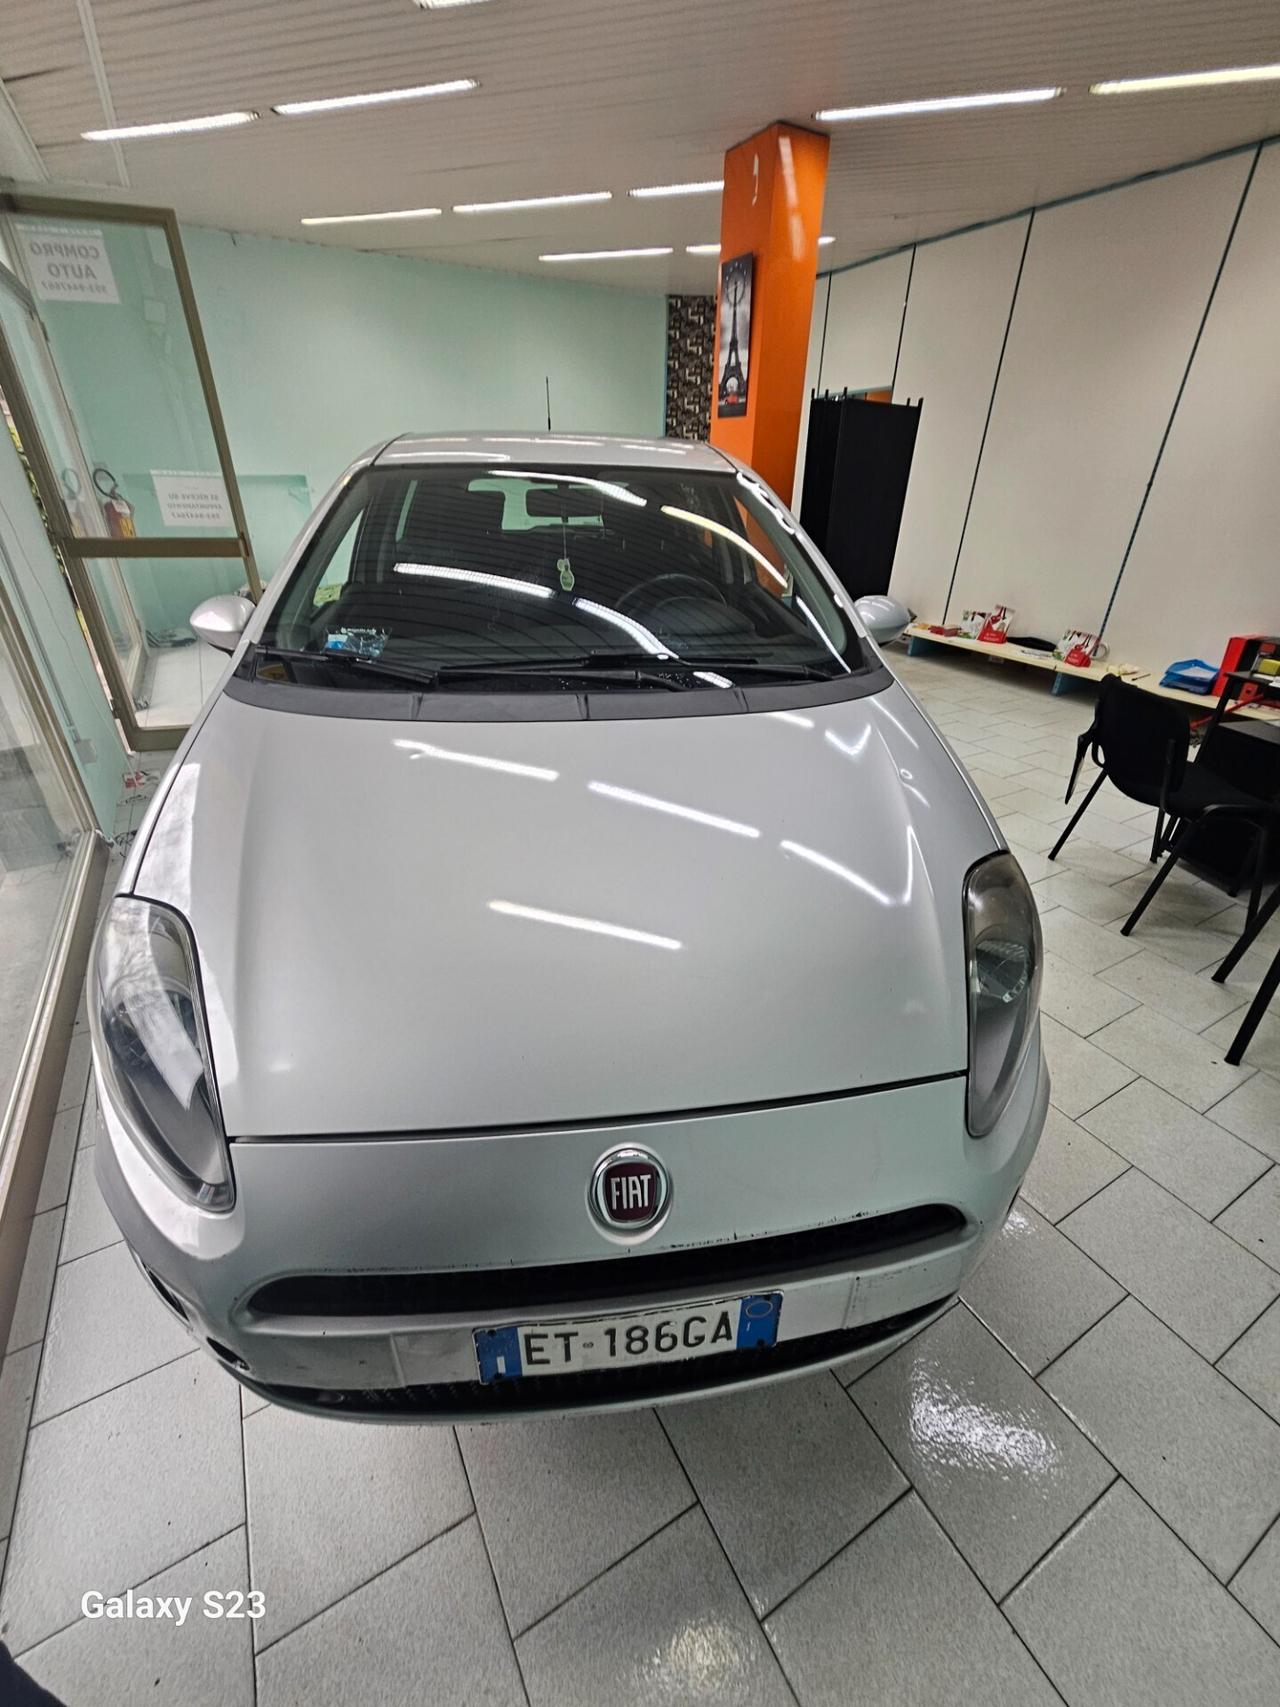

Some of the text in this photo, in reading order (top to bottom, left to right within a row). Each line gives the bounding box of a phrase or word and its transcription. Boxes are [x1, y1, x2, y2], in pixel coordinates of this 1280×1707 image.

[610, 1174, 651, 1211] FIAT
[524, 1311, 733, 1366] ET 186GA
